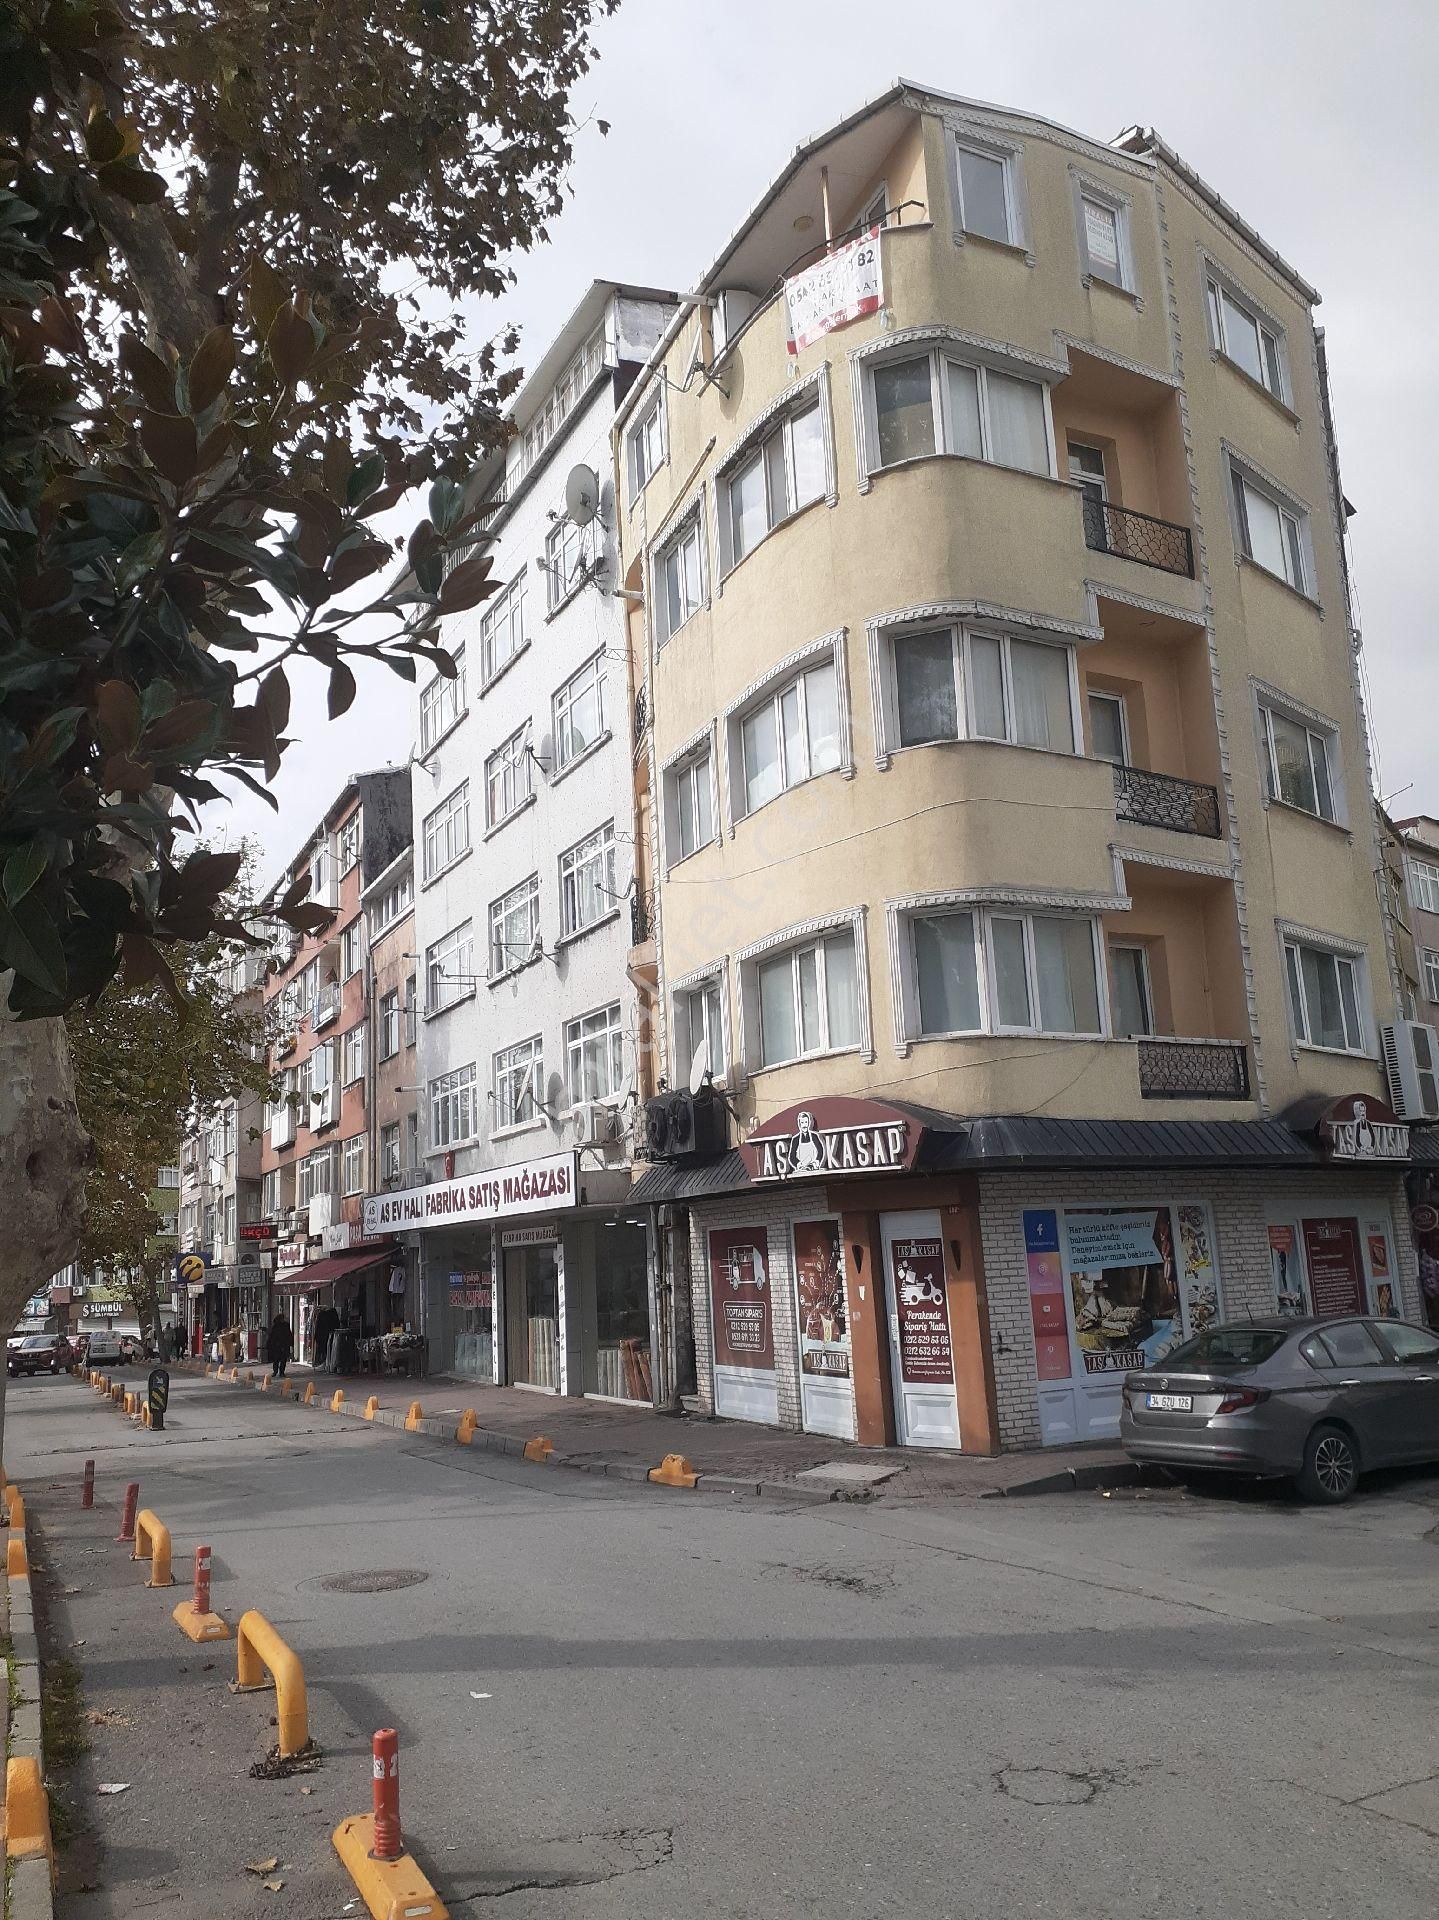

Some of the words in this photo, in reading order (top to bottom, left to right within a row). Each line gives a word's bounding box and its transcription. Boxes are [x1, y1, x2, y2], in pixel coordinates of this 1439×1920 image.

[825, 1127, 901, 1169] KASAP
[1374, 1126, 1410, 1156] KASAP
[380, 1203, 390, 1223] AS
[392, 1201, 402, 1221] EV
[404, 1198, 423, 1220] HALI
[425, 1185, 467, 1216] FABRİKA
[468, 1181, 500, 1212] SATIŞ
[503, 1166, 571, 1203] MAĞAZASI
[90, 1301, 123, 1313] SÜMBÜL
[1116, 1352, 1143, 1369] KASAP
[1151, 1396, 1159, 1407] 34
